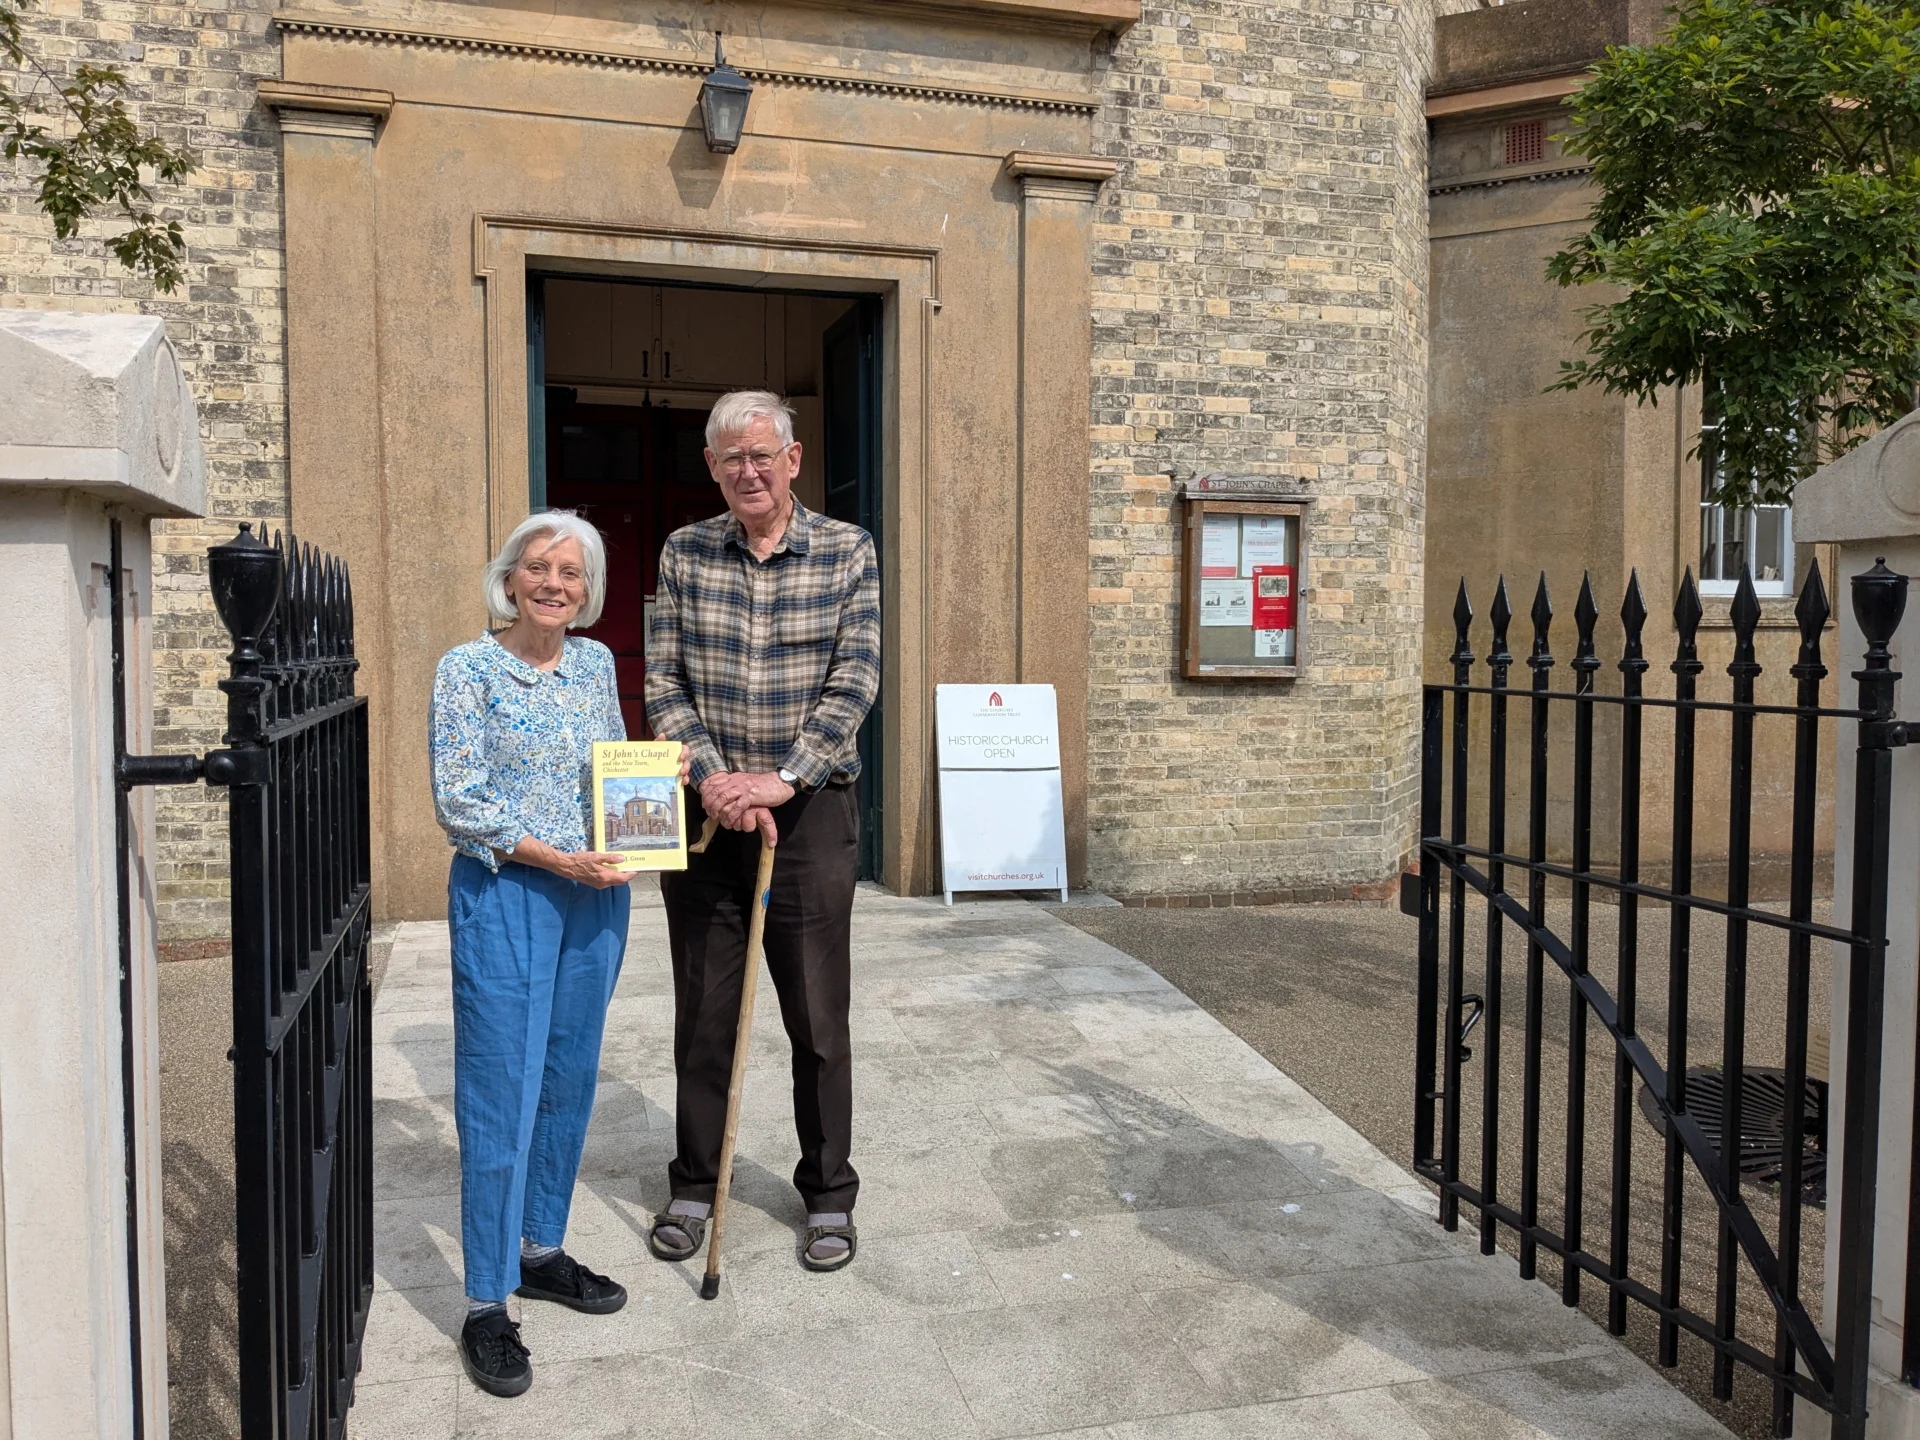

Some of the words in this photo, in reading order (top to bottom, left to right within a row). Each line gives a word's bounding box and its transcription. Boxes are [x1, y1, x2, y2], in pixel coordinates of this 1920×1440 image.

[1225, 480, 1255, 489] JOHN'S
[1257, 480, 1291, 489] CHAPEL
[948, 735, 1000, 746] HISTORIC
[1001, 735, 1049, 745] CHURCH
[602, 749, 612, 759] St
[612, 749, 639, 761] John's
[640, 749, 670, 761] Chapel
[983, 748, 1016, 759] OPEN
[967, 872, 1045, 881] visitchurches.org.uk
